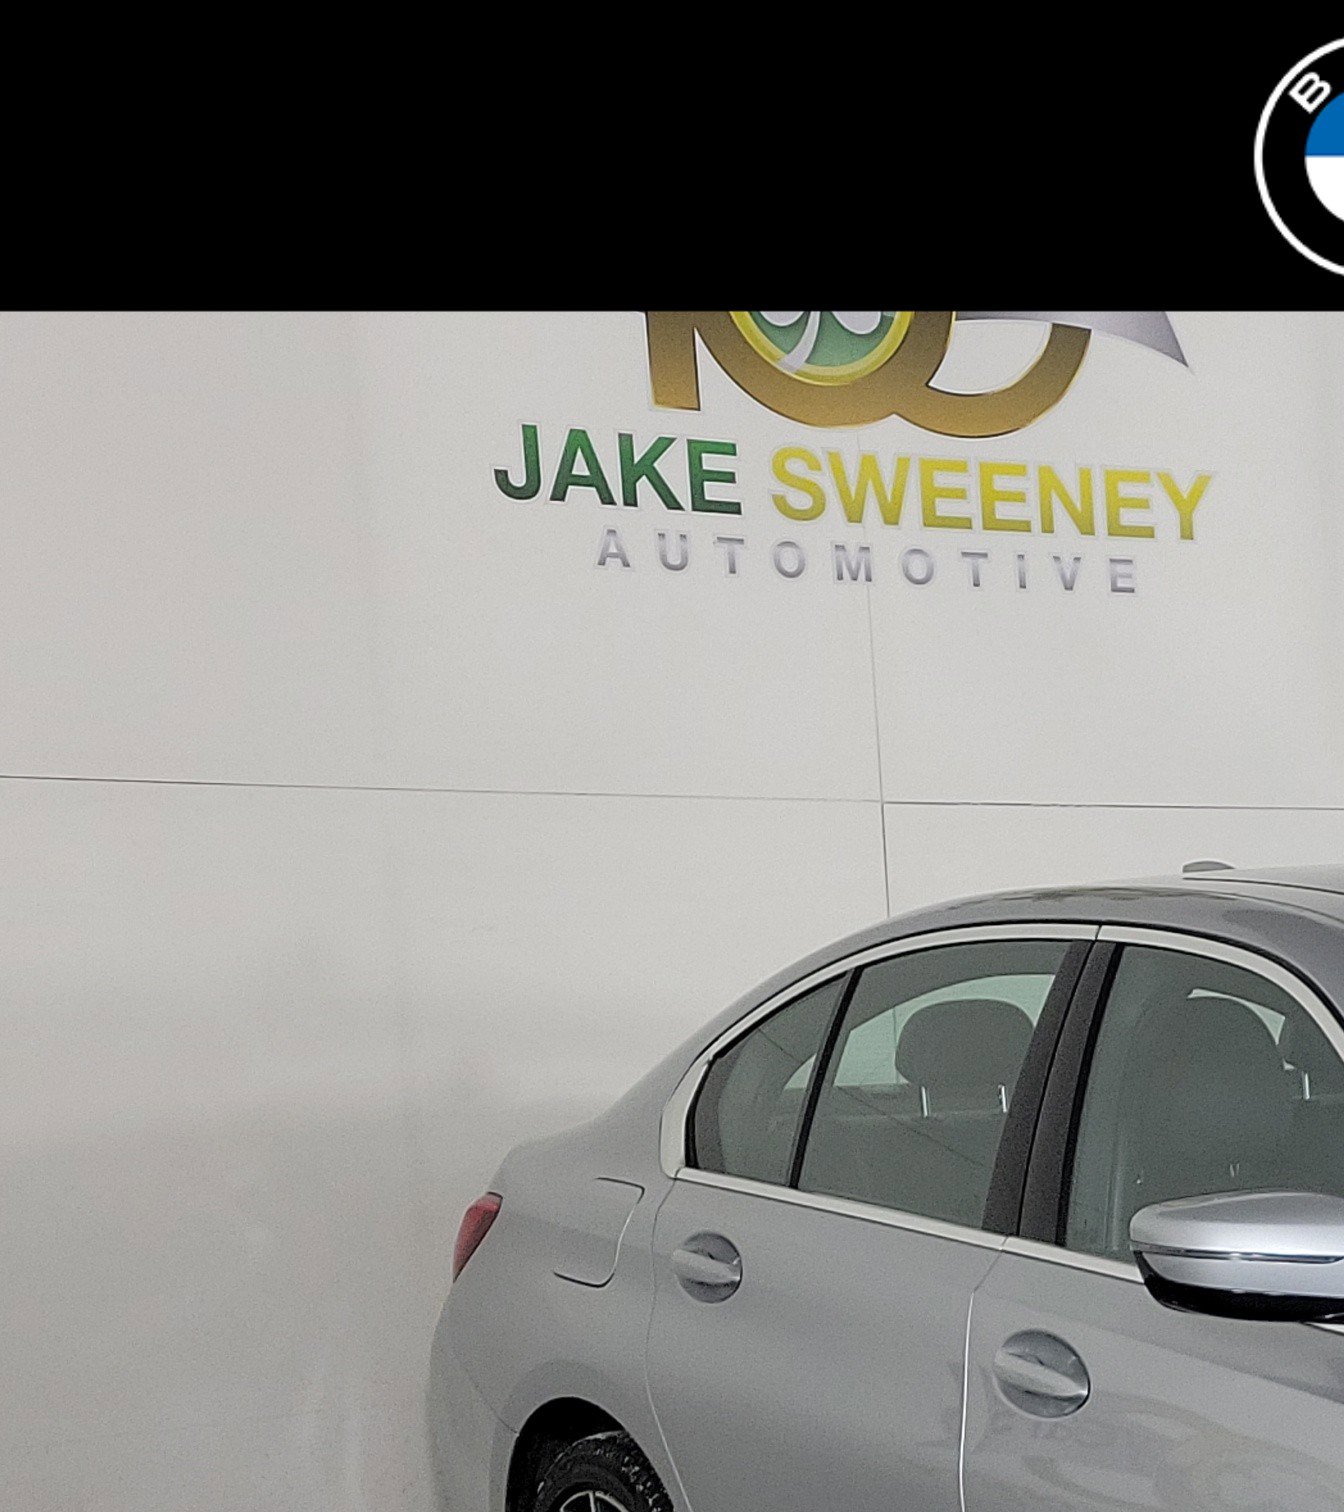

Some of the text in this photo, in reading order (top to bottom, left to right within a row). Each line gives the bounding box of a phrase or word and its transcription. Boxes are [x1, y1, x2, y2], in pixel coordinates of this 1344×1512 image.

[493, 423, 1213, 541] JAKE SWEENEY
[596, 528, 1138, 594] AUTOMOTIVE
